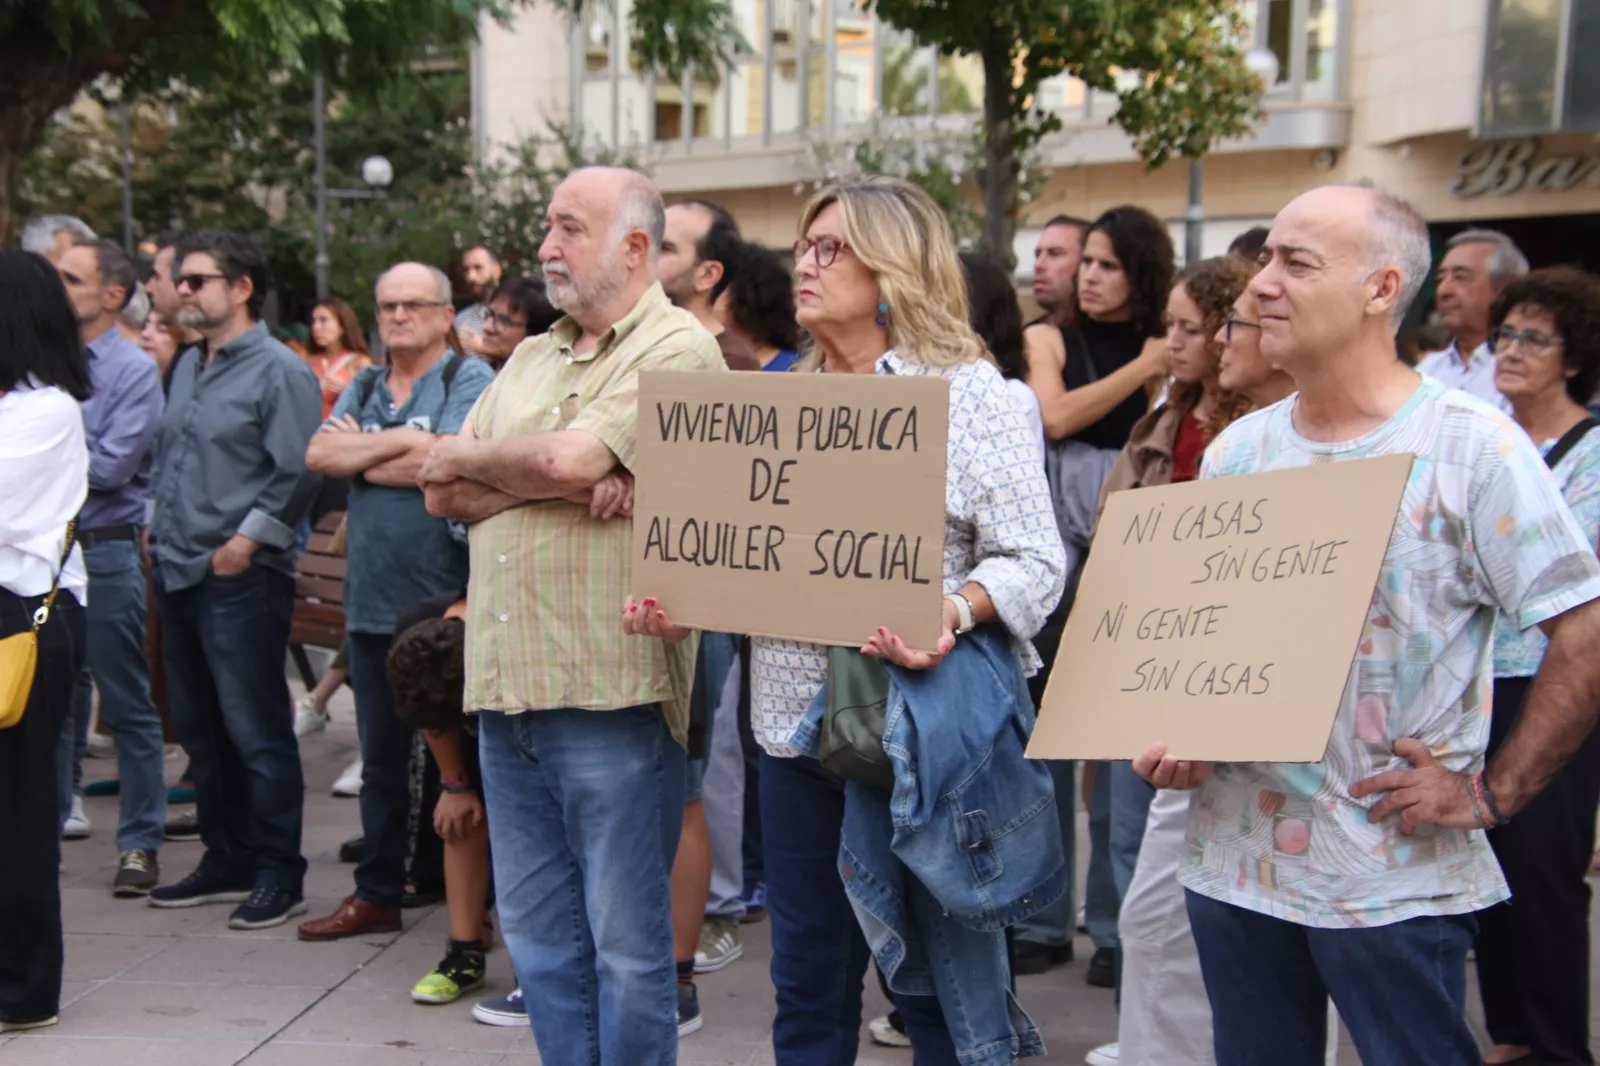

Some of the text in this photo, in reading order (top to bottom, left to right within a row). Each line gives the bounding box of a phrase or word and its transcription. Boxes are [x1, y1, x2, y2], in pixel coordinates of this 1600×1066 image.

[656, 401, 918, 452] VIVIENDA PUBLICA
[749, 457, 798, 505] DE
[1172, 498, 1269, 540] CASAS
[644, 516, 930, 584] ALQUILER SOCIAL
[1251, 540, 1349, 582] GENTE
[1137, 604, 1229, 641] GENTE
[1121, 657, 1275, 696] SIN CASAS
